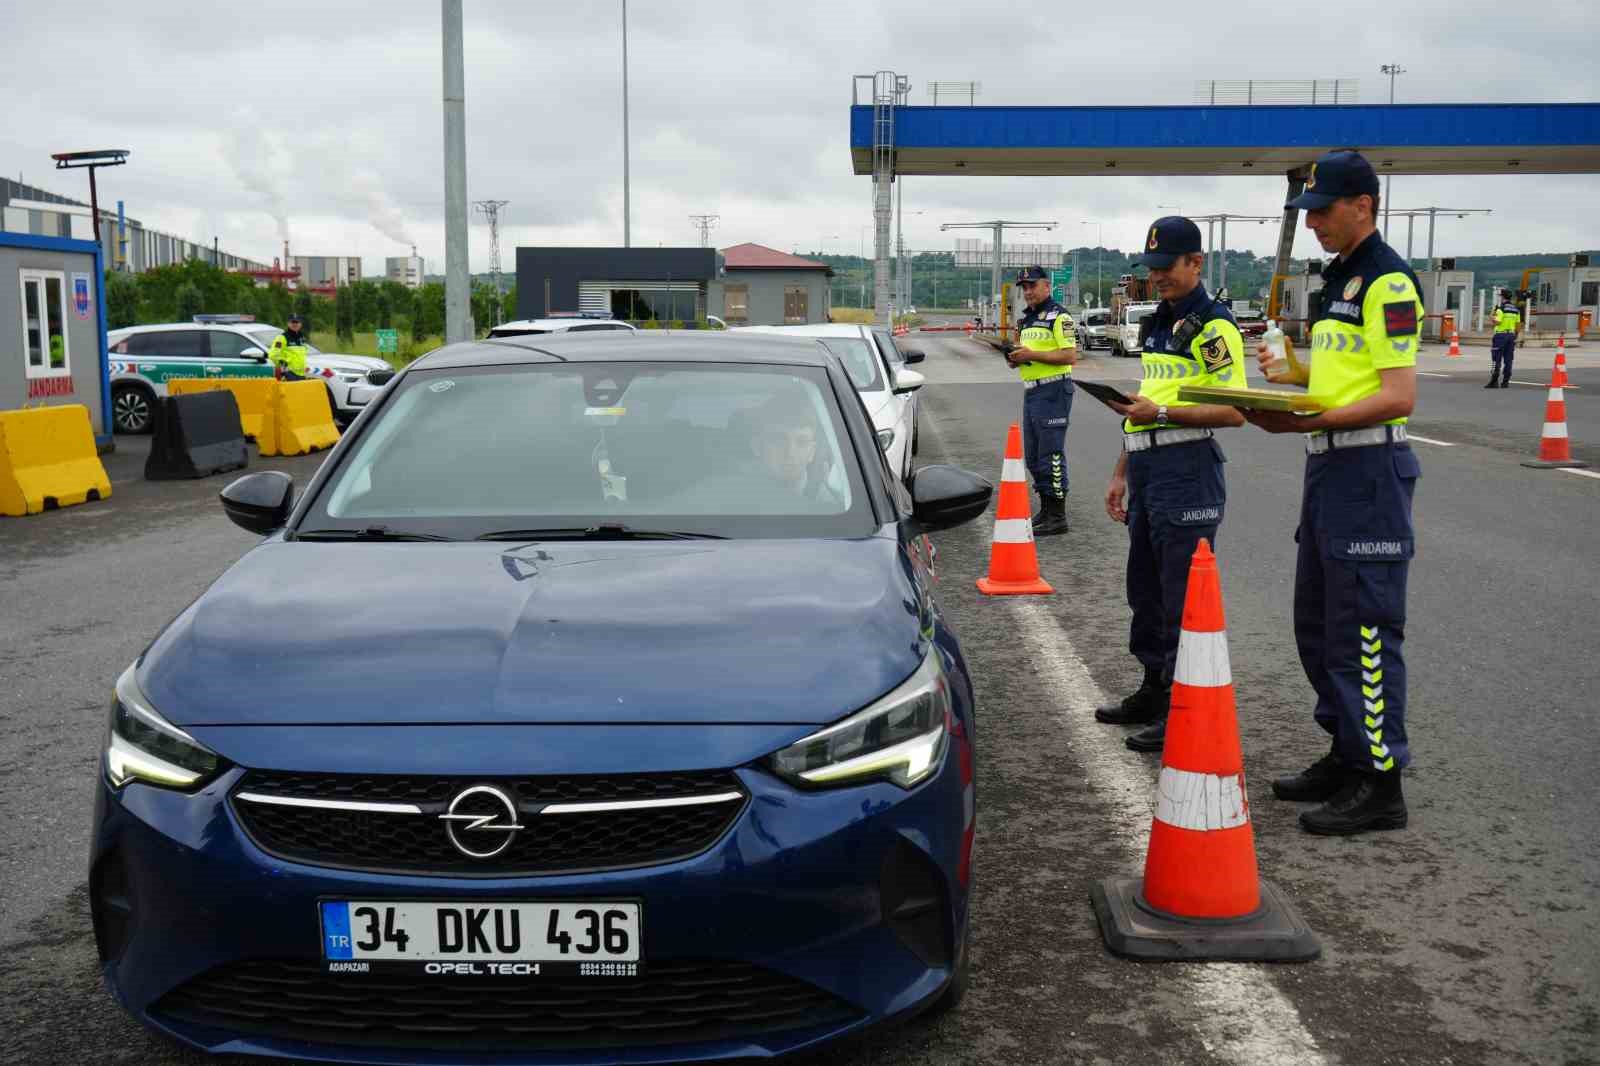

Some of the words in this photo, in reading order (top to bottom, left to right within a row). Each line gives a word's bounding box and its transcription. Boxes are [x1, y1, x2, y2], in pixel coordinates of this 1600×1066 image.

[28, 376, 75, 400] JANDARMA
[1182, 508, 1218, 521] JANDARMA
[1347, 542, 1402, 555] JANDARMA
[354, 906, 410, 952] 34
[437, 908, 521, 954] DKU
[547, 909, 629, 955] 436
[329, 935, 349, 948] TR
[328, 962, 370, 973] ADAPAZARI
[424, 962, 484, 974] OPEL
[487, 963, 540, 975] TECH
